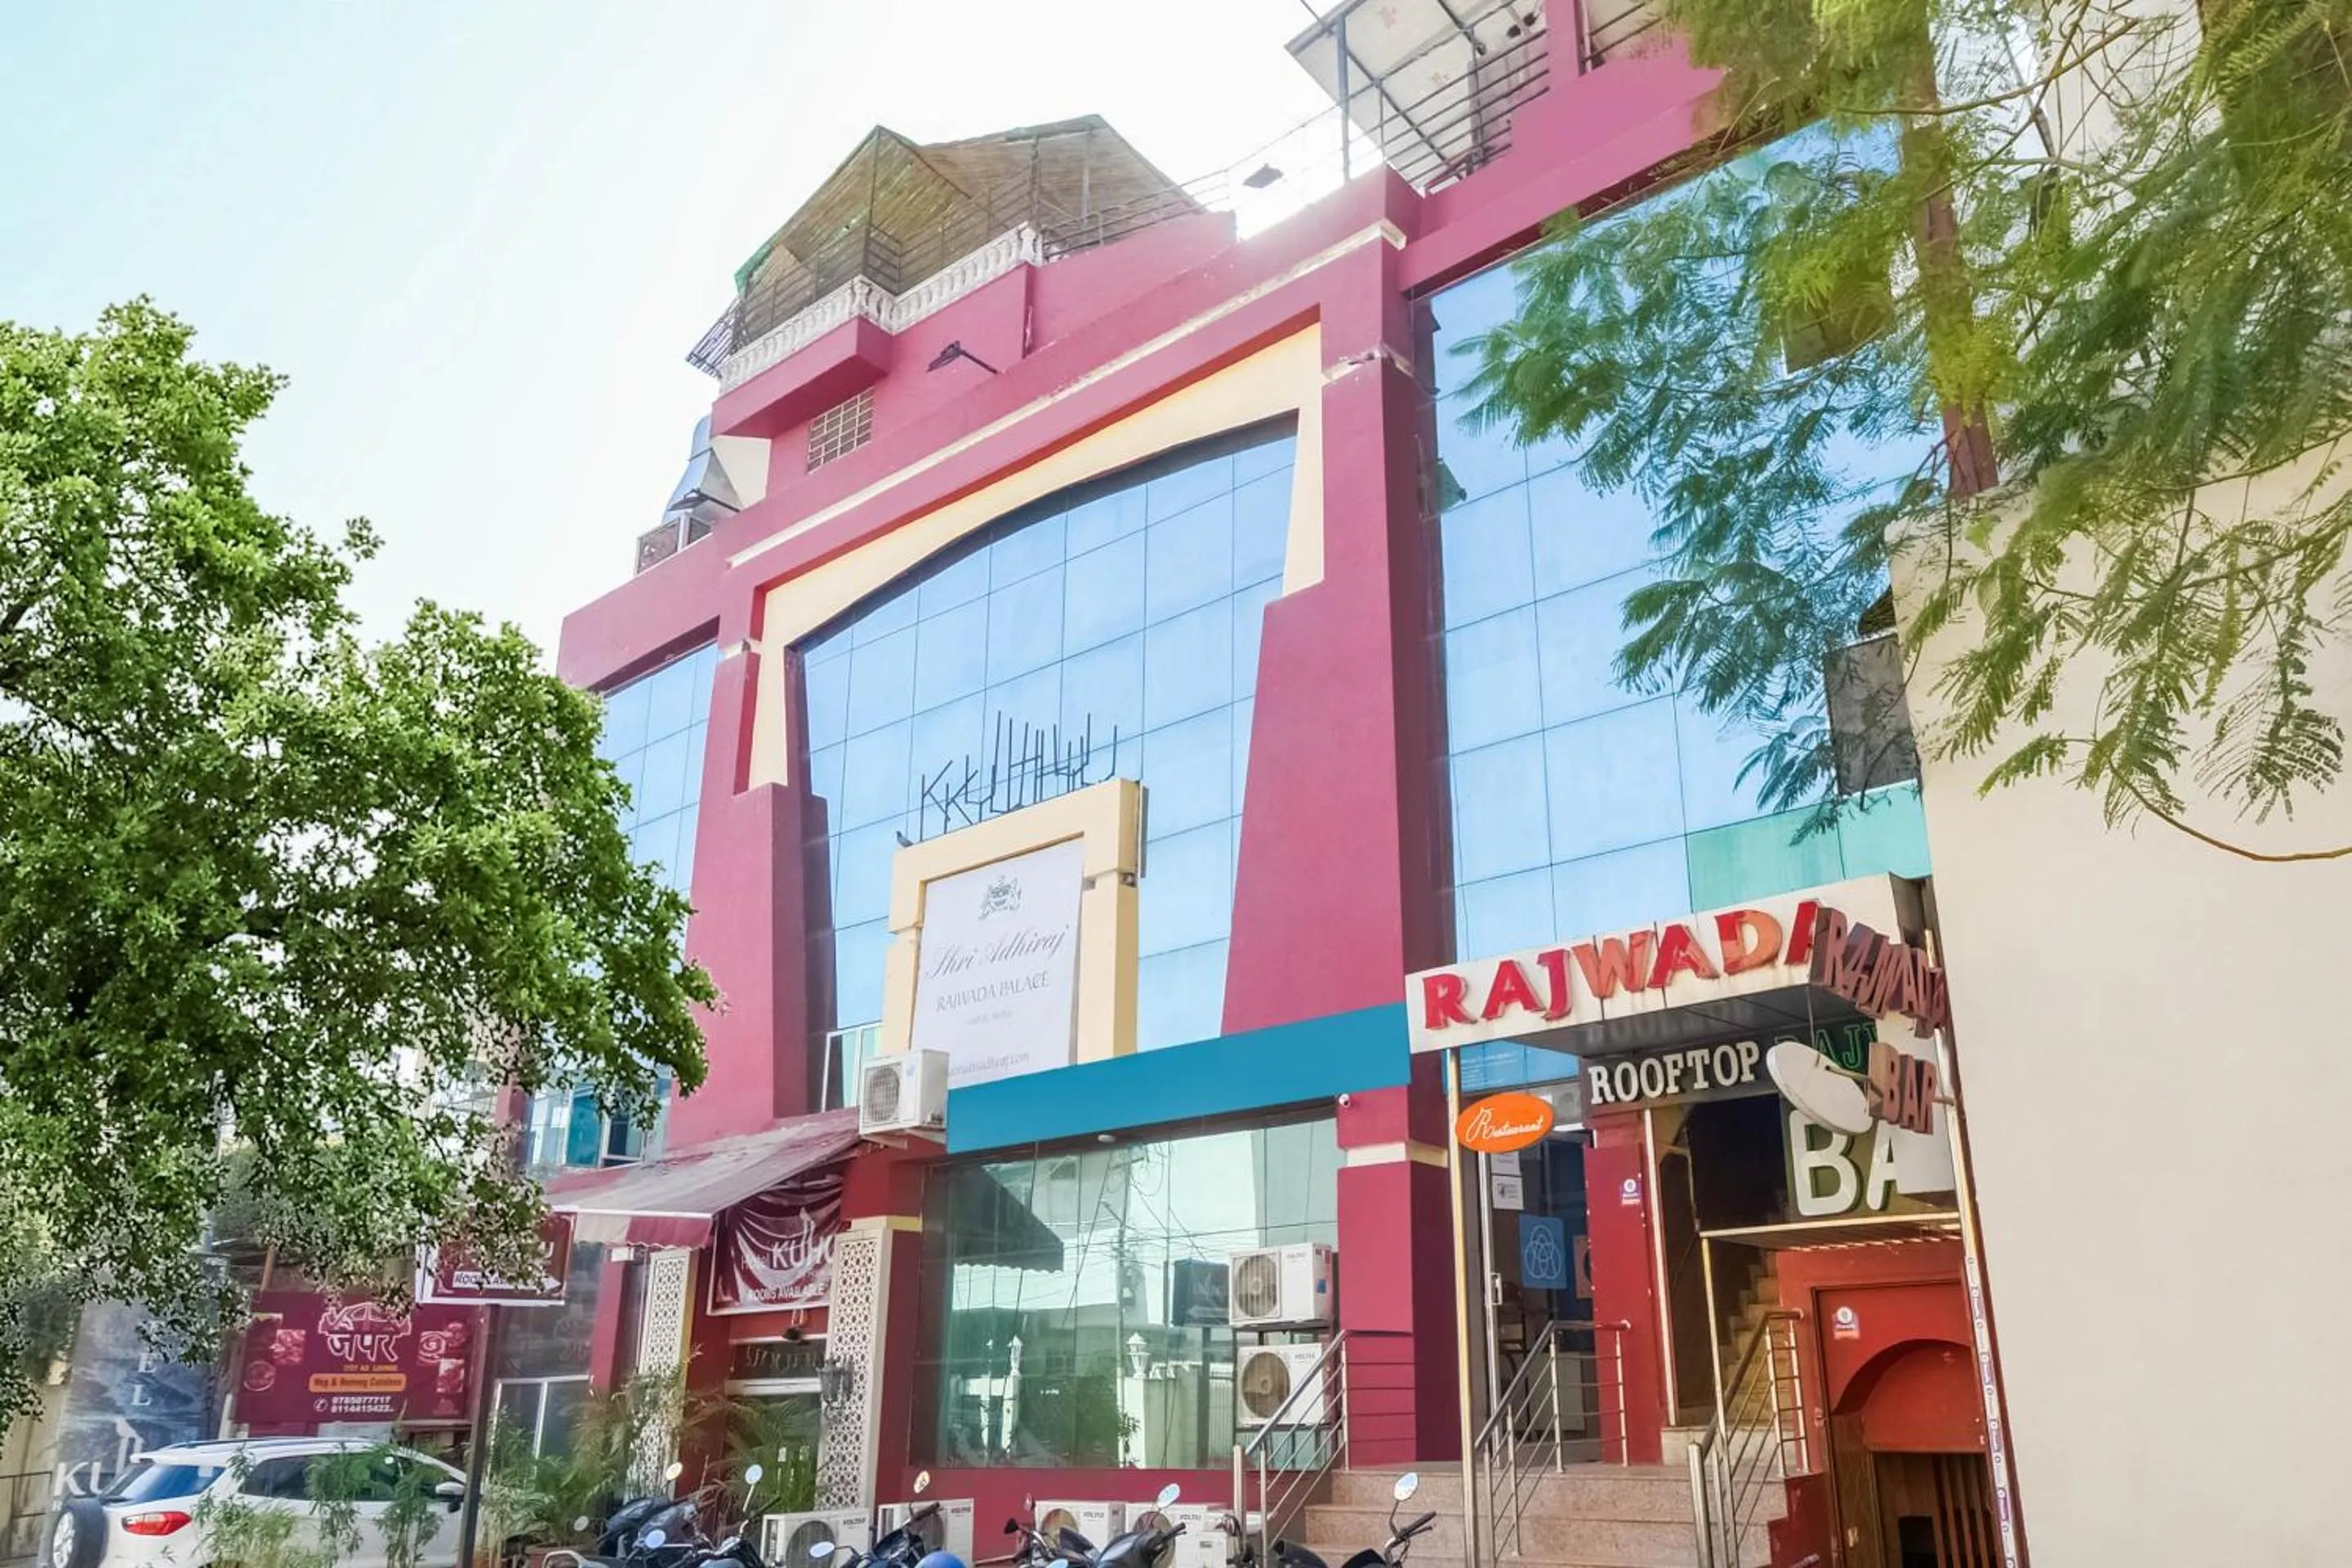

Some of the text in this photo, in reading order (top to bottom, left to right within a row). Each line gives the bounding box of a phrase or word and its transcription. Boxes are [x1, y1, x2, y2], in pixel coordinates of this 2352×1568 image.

[1000, 970, 1050, 997] PALACE
[1588, 1040, 1761, 1105] ROOFTOP
[1870, 1043, 1938, 1135] BAR
[1465, 1107, 1545, 1144] Restaurant
